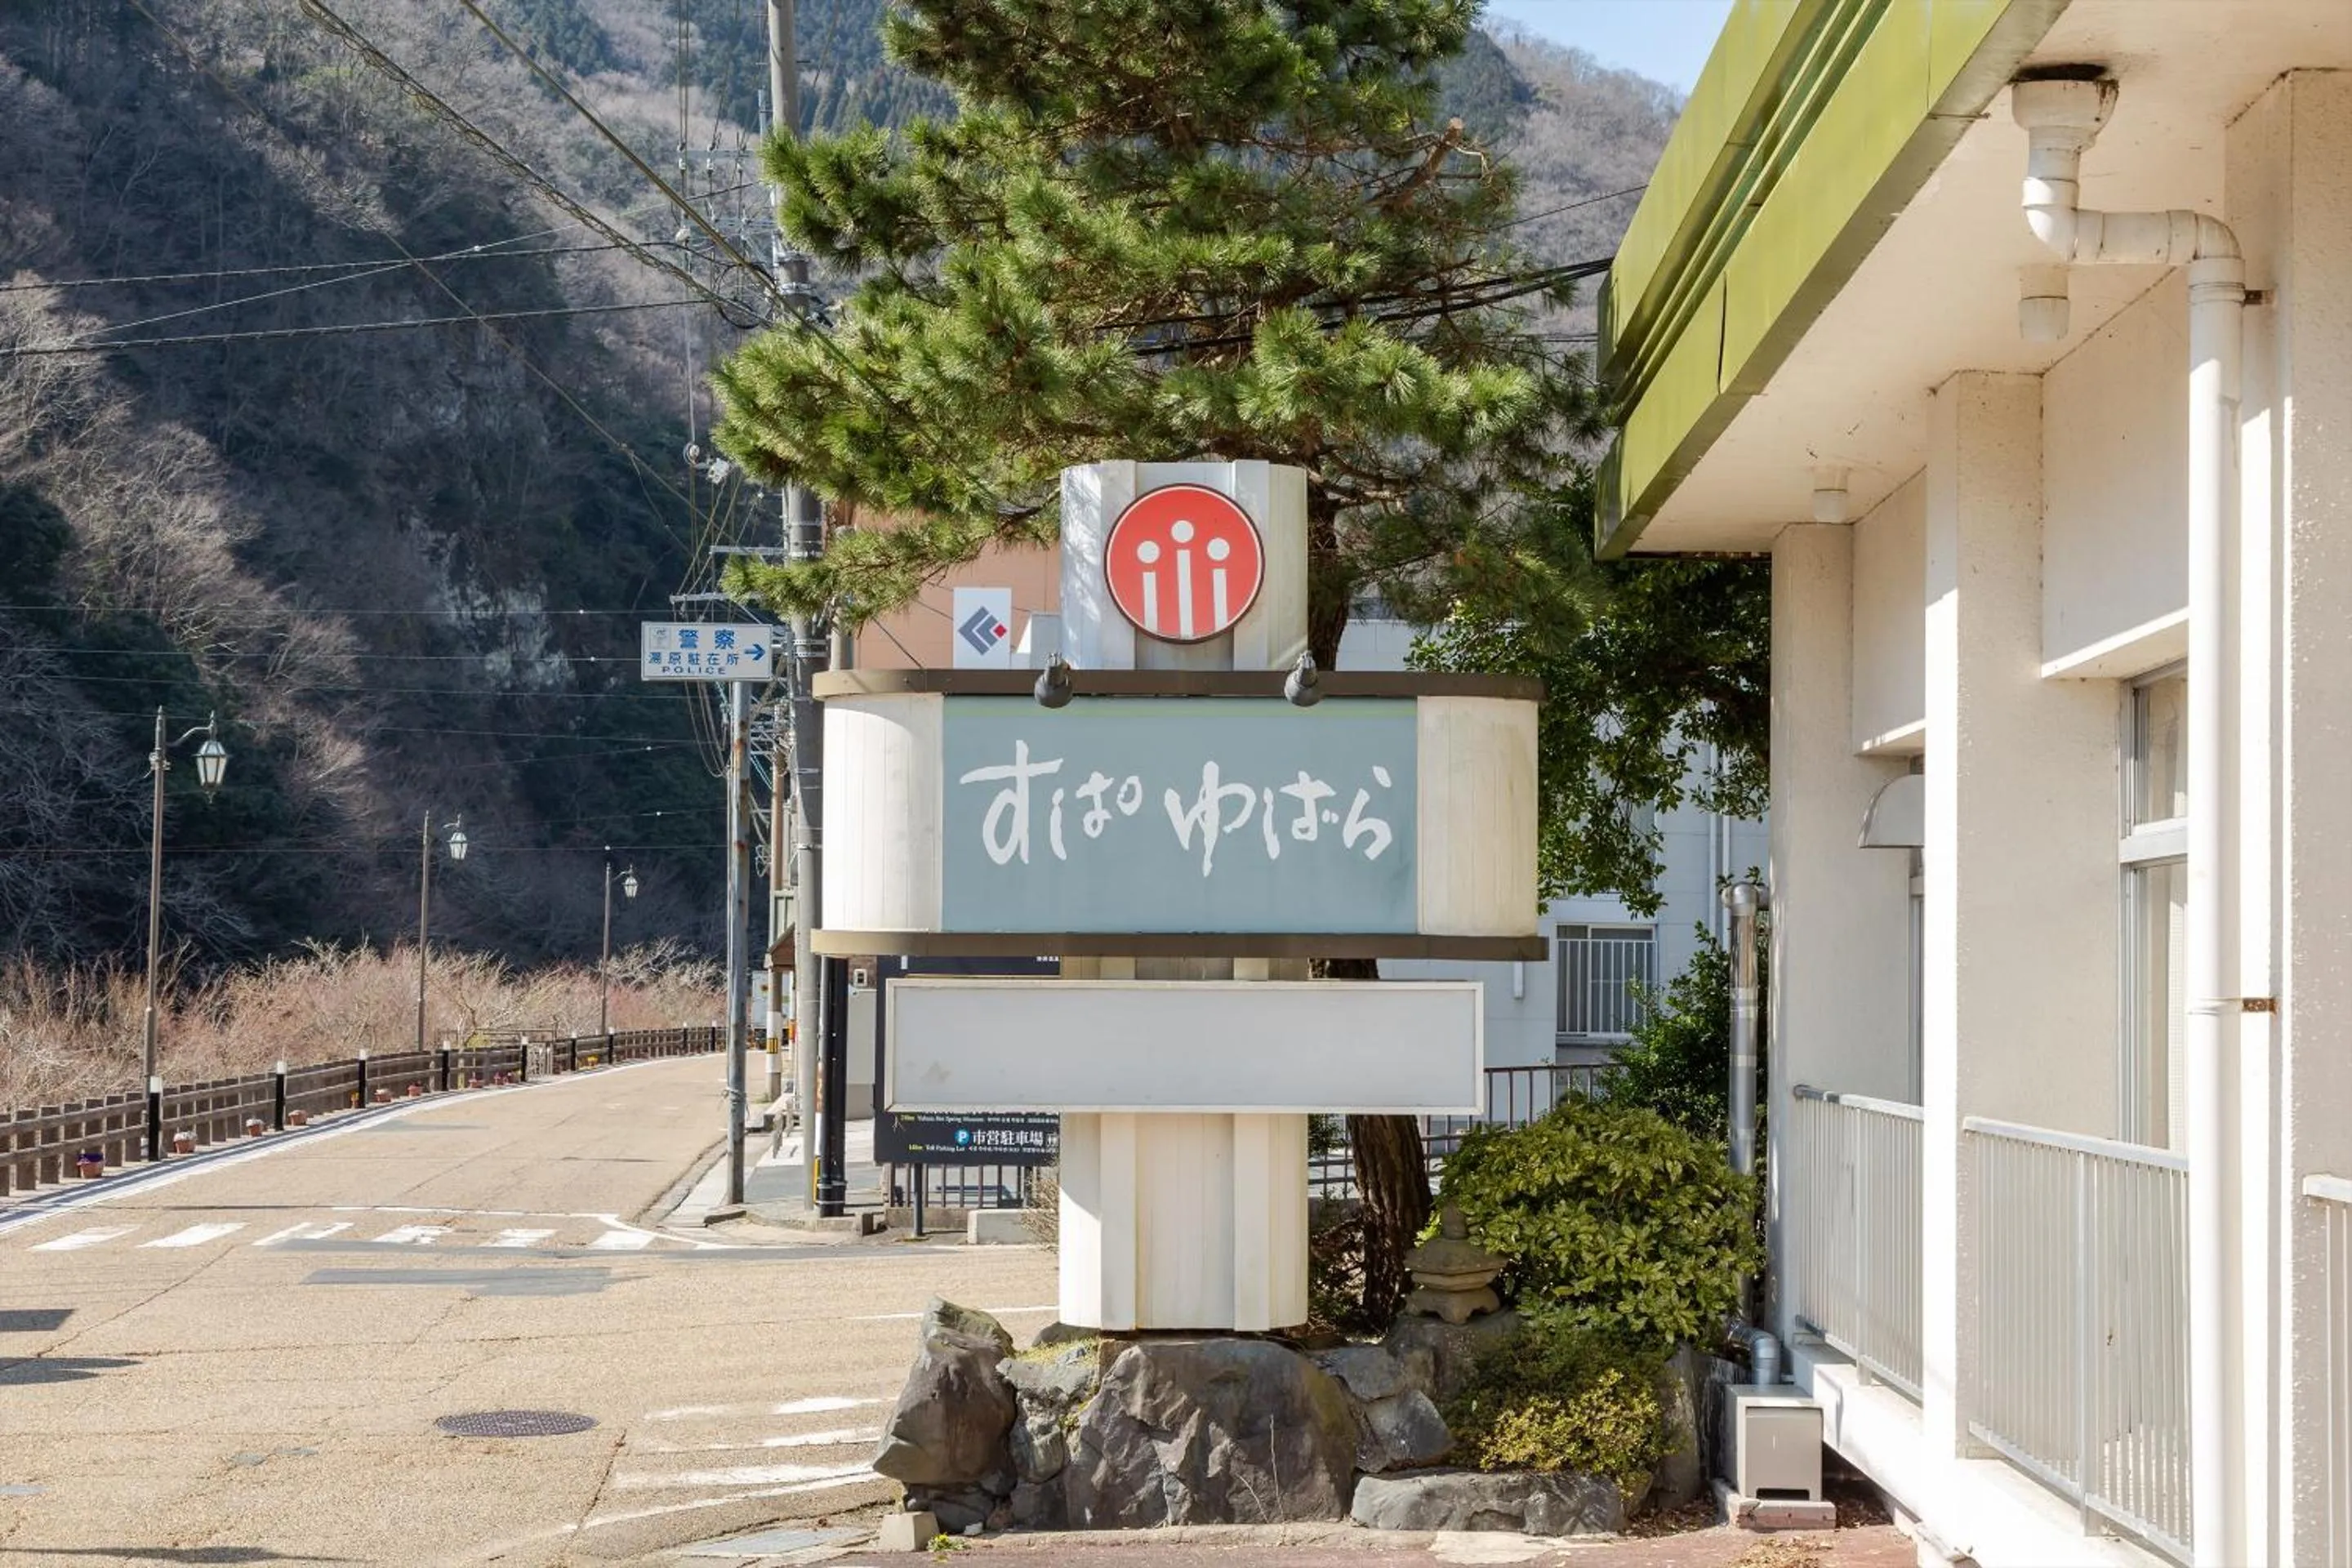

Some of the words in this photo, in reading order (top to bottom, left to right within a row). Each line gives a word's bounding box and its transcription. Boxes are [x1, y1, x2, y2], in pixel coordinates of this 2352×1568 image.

[679, 629, 735, 650] 警察
[648, 652, 739, 666] 湯原駐在所
[662, 666, 726, 675] POLICE
[972, 1129, 1044, 1147] 市営駐車場
